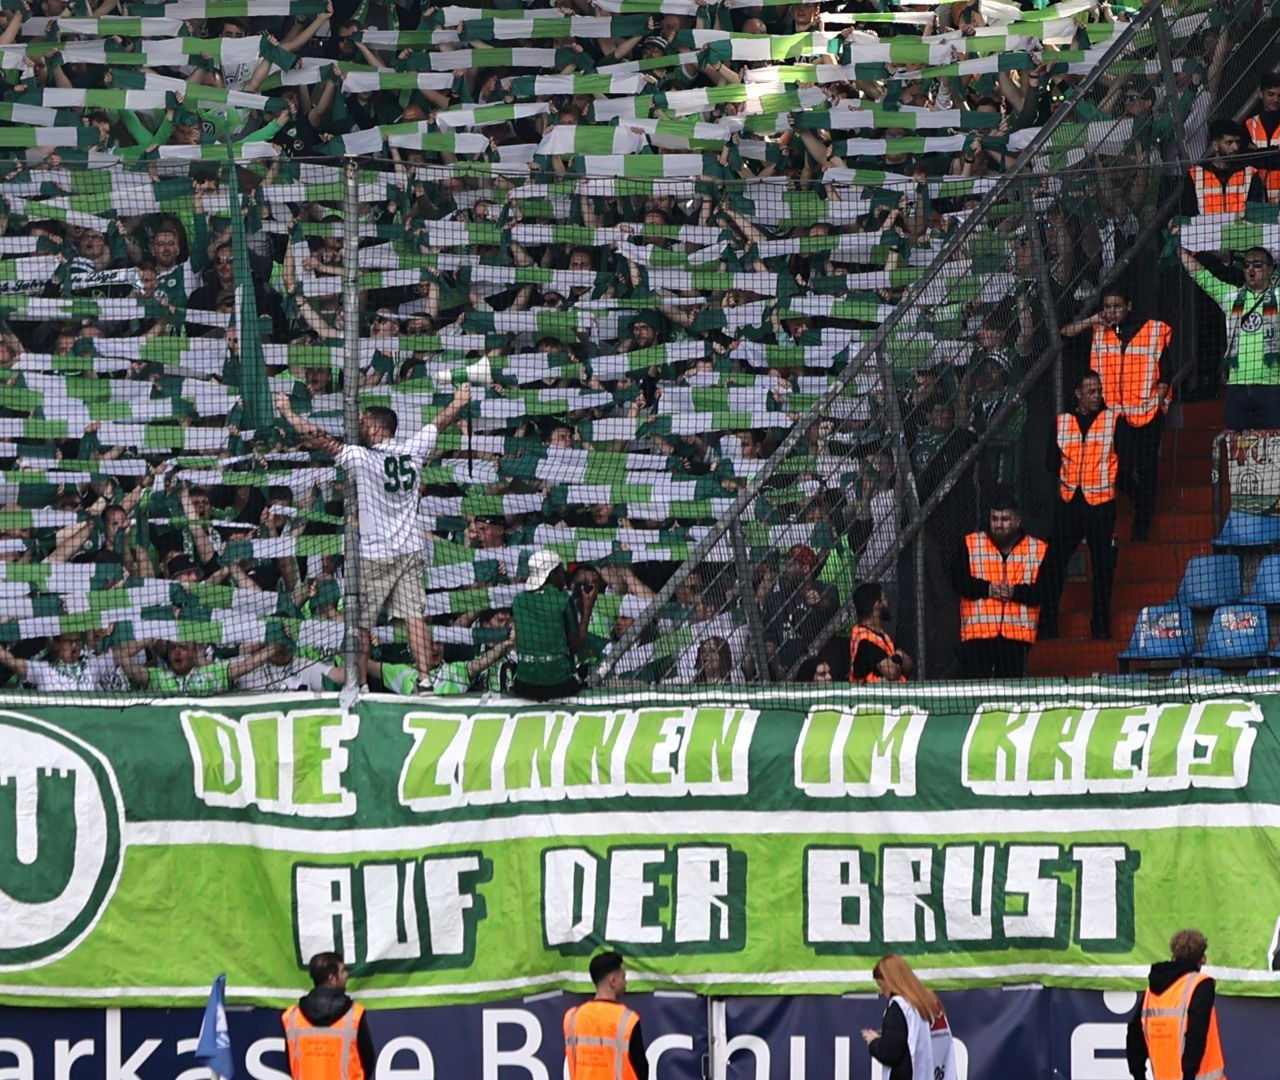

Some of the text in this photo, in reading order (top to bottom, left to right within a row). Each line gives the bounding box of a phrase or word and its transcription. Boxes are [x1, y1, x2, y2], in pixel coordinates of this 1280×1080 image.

[383, 455, 417, 493] 95
[181, 700, 1264, 816] DIE ZINNEN IM KREIS
[295, 842, 1130, 968] AUF DER BRUST
[481, 998, 969, 1080] Bchu
